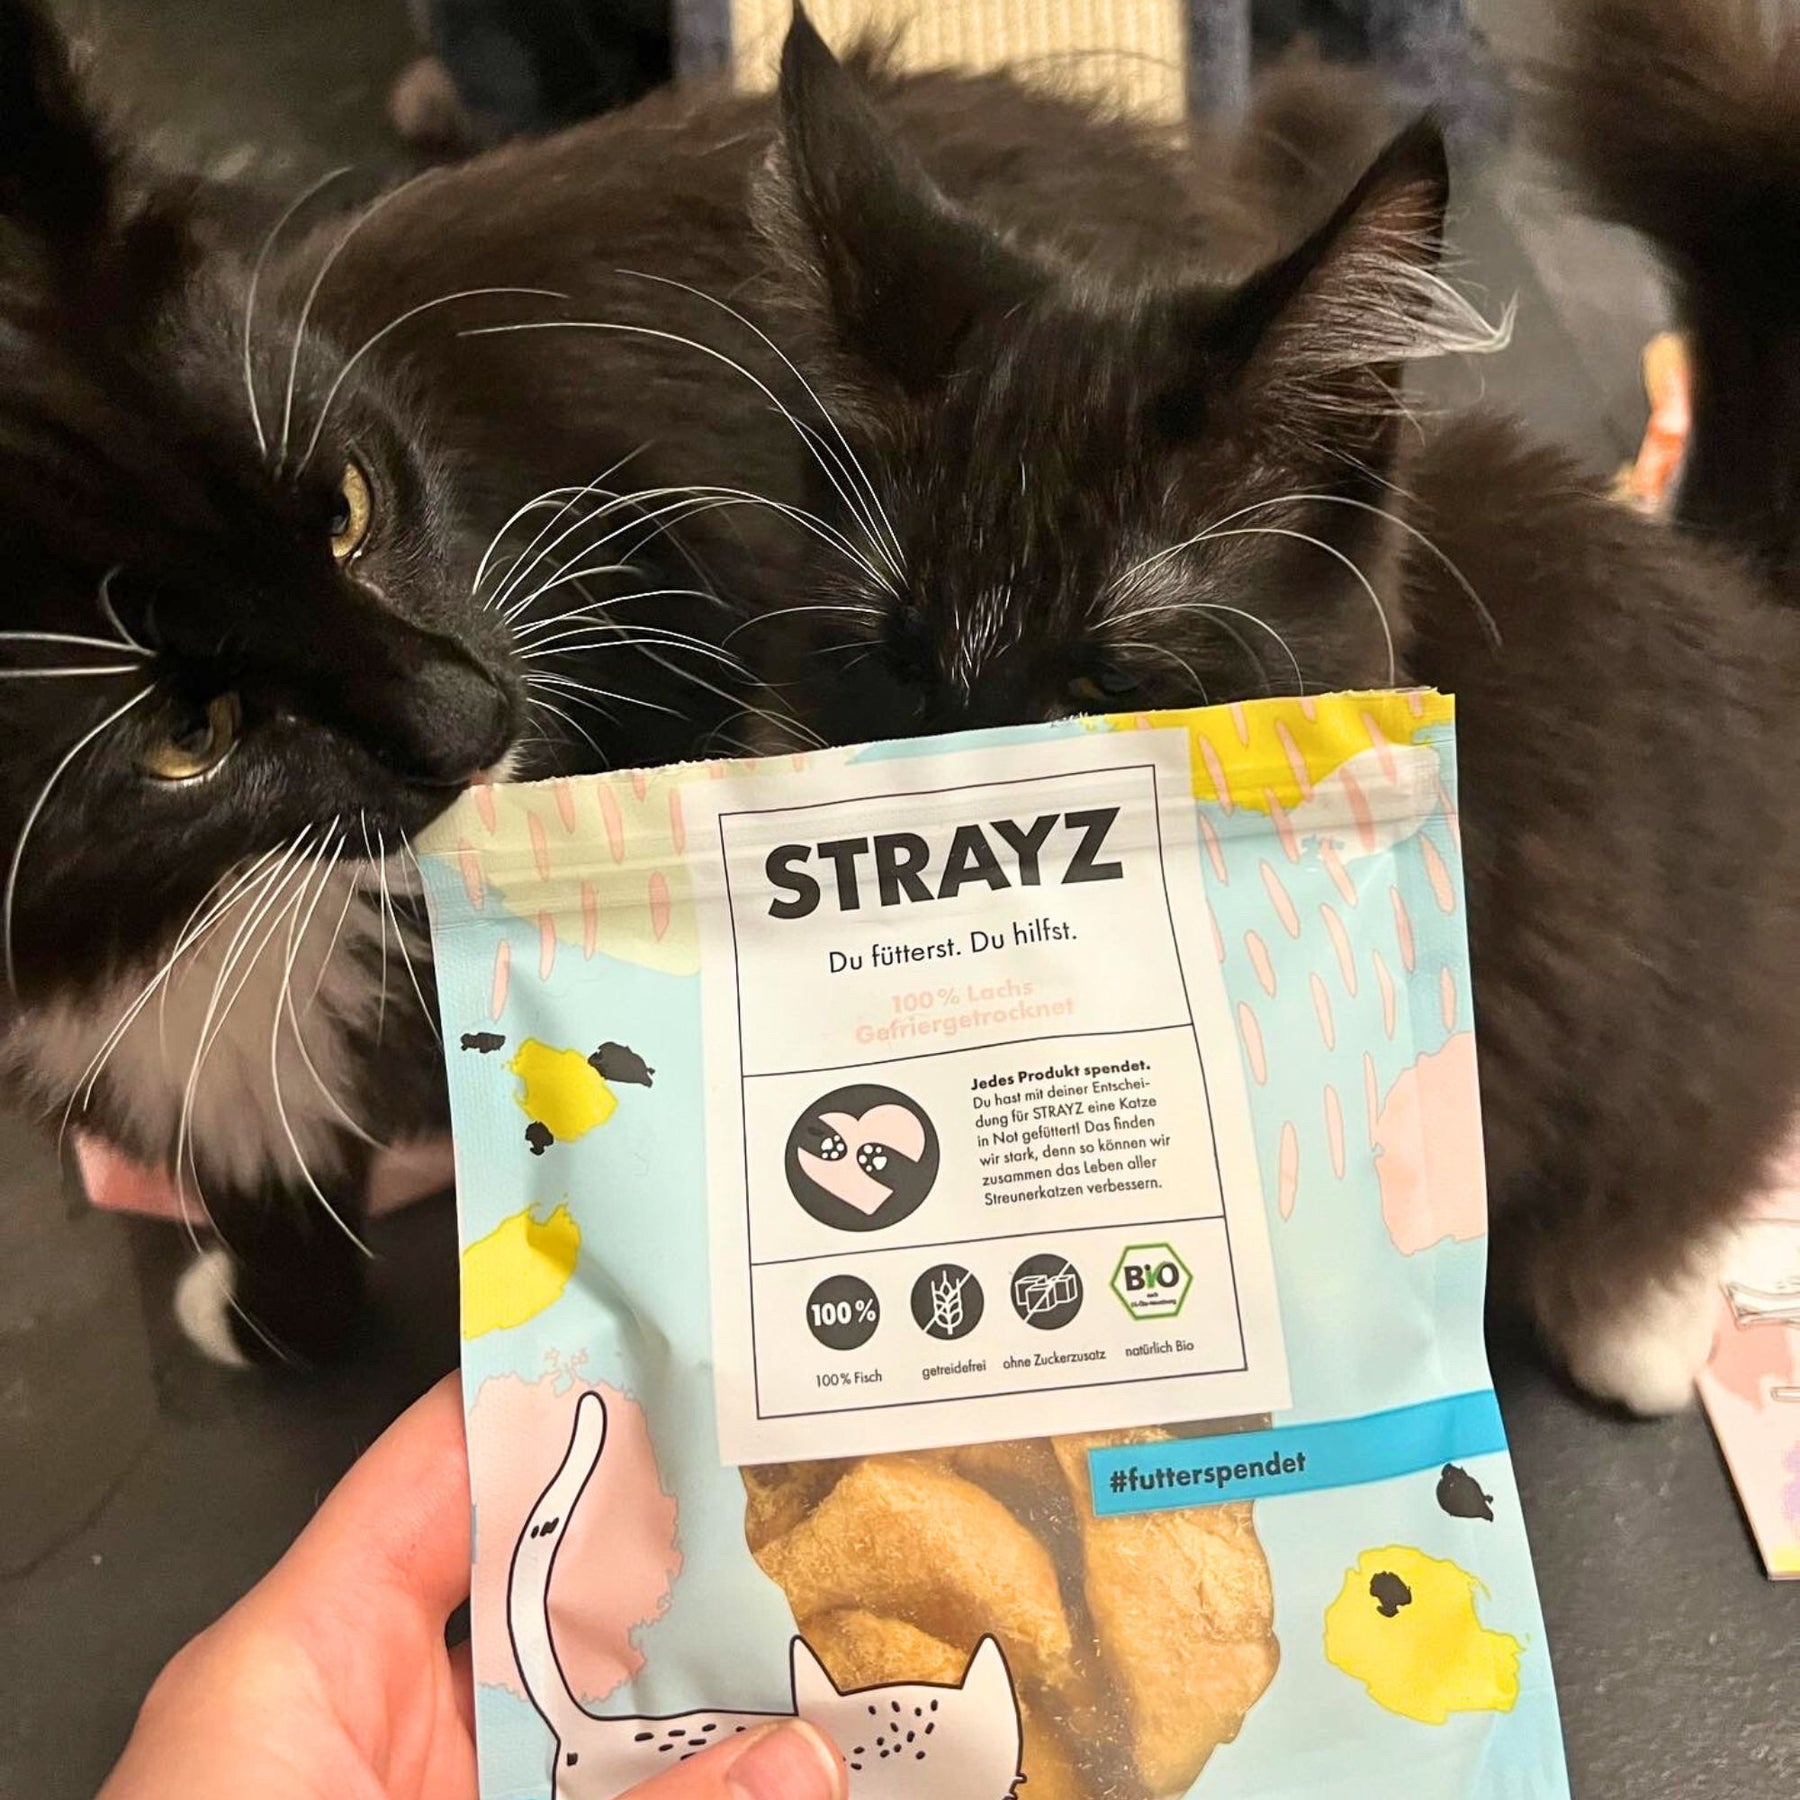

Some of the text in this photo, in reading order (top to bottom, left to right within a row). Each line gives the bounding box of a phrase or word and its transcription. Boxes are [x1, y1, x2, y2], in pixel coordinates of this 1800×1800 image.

[765, 807, 1124, 920] STRAYZ
[829, 917, 1078, 974] Du fütterst. Du hilfst.
[967, 979, 1035, 1002] Lachs
[855, 997, 1075, 1044] Gefriergetrocknet
[970, 1060, 1151, 1091] Jedes Produkt spendet.
[973, 1077, 1151, 1109] Du hast mit deiner Entschei-
[975, 1096, 1157, 1128] dung für STRAYZ eine Katze
[977, 1115, 1155, 1147] in Not gefüttert! Das finden
[980, 1133, 1171, 1166] wir stark, denn so können wir
[982, 1155, 1157, 1187] zusammen das Leben aller
[984, 1178, 1163, 1206] Streunerkatzen verbessern.
[1002, 1350, 1106, 1370] ohne Zuckerzusatz
[1126, 1339, 1195, 1357] natürlich Bio
[854, 1369, 882, 1384] Fisch
[922, 1359, 986, 1380] getreidefrei
[1109, 1451, 1306, 1494] #futterspendet
